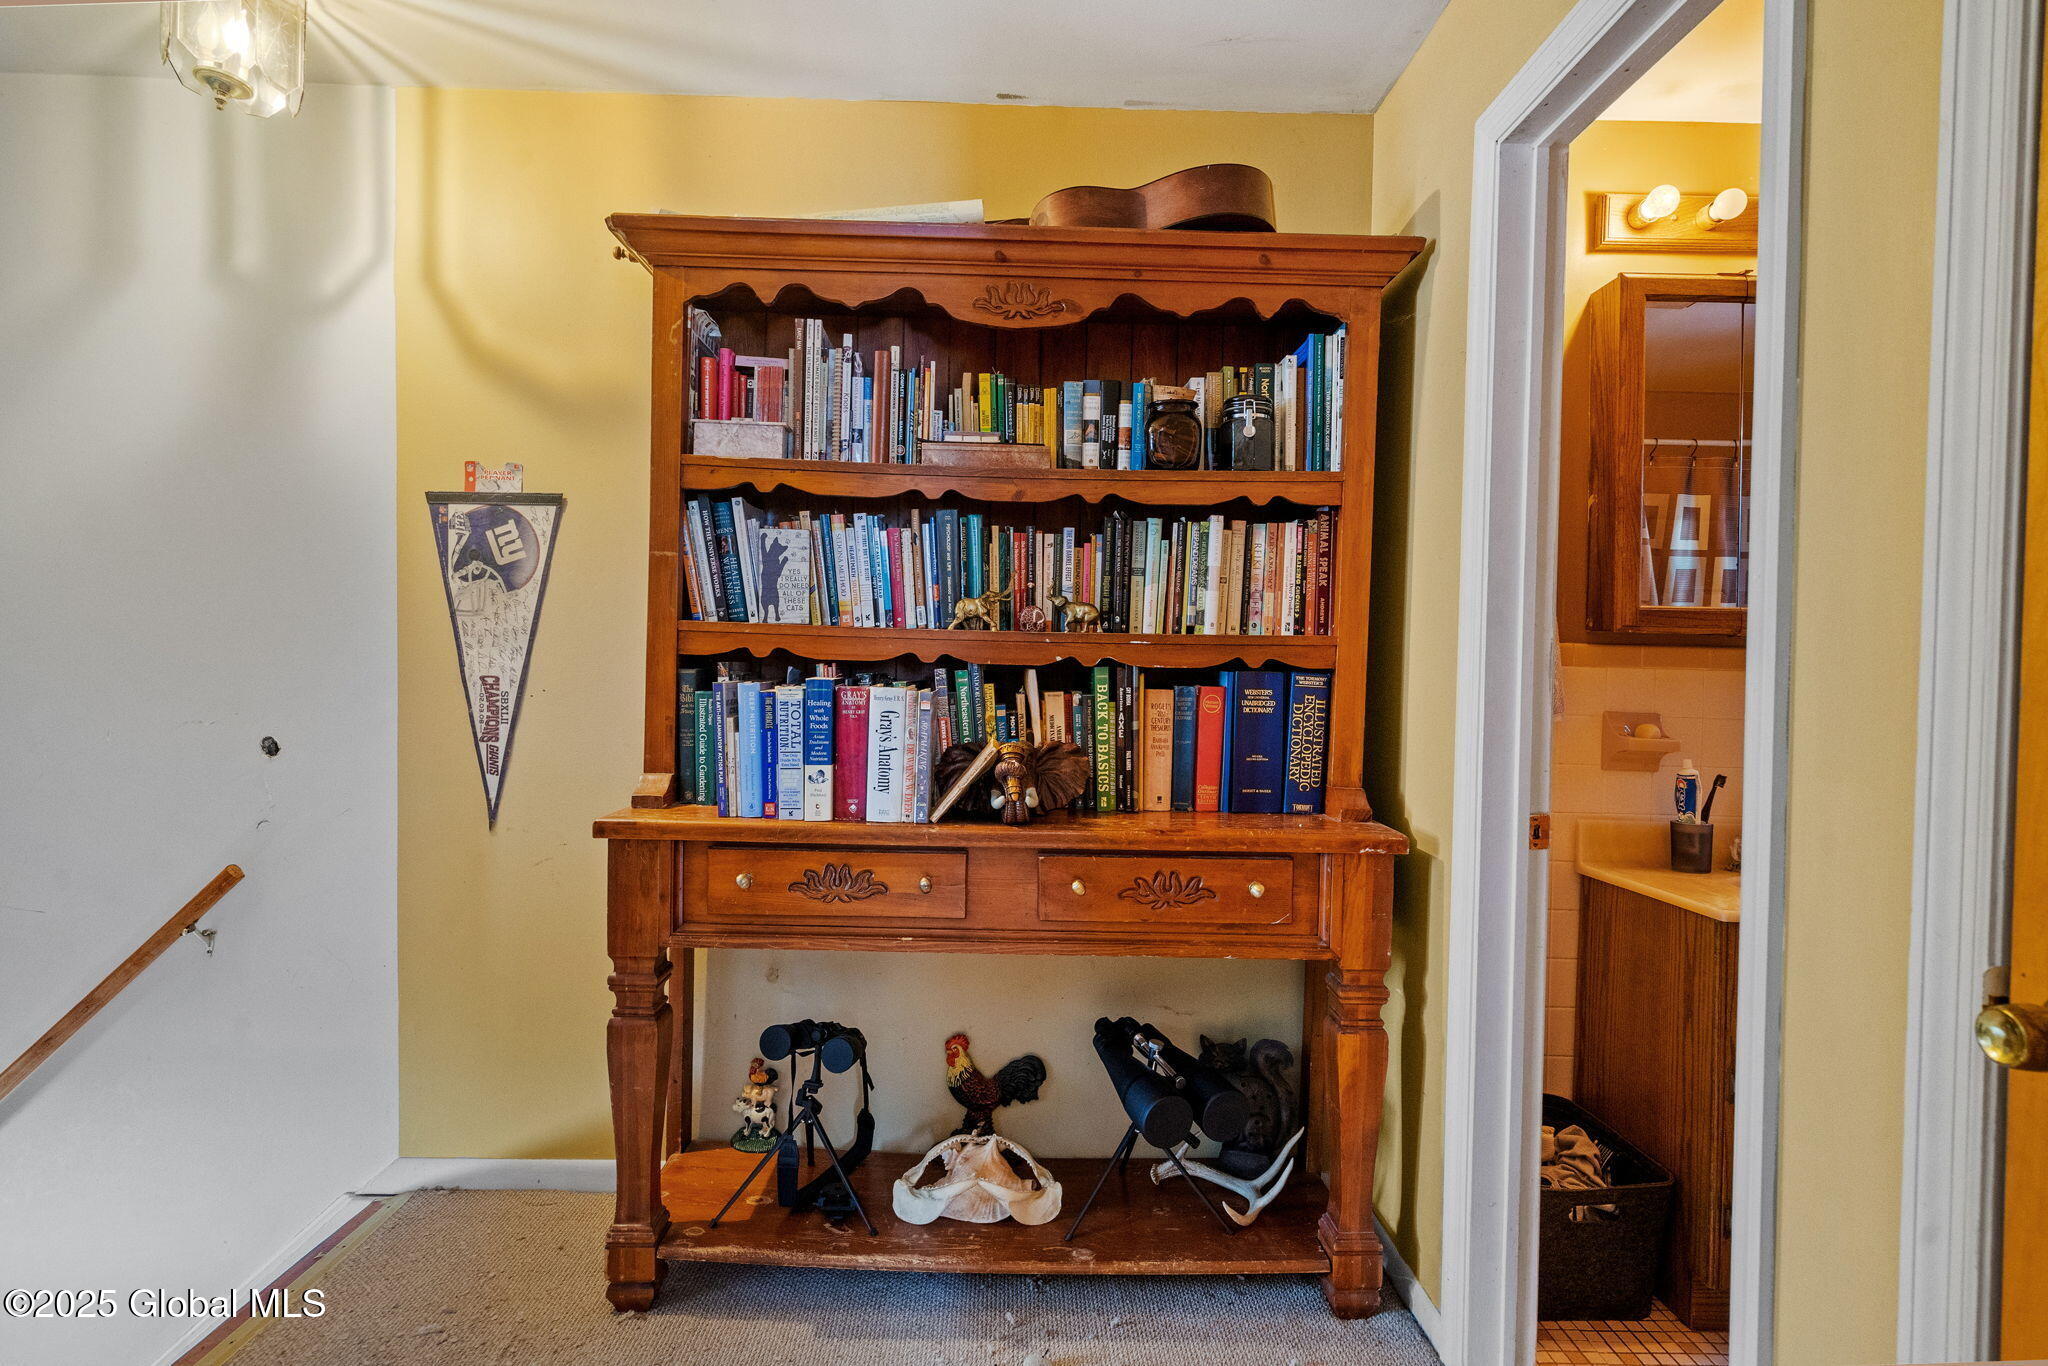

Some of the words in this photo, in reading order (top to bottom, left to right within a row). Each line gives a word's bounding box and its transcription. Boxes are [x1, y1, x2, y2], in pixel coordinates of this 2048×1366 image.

[836, 533, 844, 562] SEDONA
[1320, 514, 1329, 553] ANIMAL
[707, 542, 716, 573] UNIVERSE
[712, 575, 721, 597] WORKS
[723, 557, 735, 604] WELLNESS
[730, 557, 741, 592] HEALTH
[839, 565, 847, 597] METHOD
[1319, 557, 1328, 586] SPEAK
[479, 675, 500, 743] CHAMPIONS
[501, 691, 509, 724] SBXLII
[841, 691, 867, 700] GRAY'S
[959, 686, 970, 735] Northeastern
[1097, 684, 1108, 720] BACK
[699, 698, 707, 732] Illustrated
[790, 701, 801, 748] TOTAL
[876, 710, 900, 742] Gray's
[950, 705, 958, 744] Blacksmith's
[1097, 724, 1108, 741] TO
[489, 744, 499, 776] GIANTS
[699, 734, 707, 754] Guide
[699, 756, 707, 764] to
[918, 720, 928, 771] SOAPMAKING
[1289, 703, 1303, 782] DICTIONARY
[1299, 694, 1315, 792] ENCYCLOPEDIC
[1311, 699, 1326, 788] ILLUSTRATED
[698, 765, 707, 801] Gardening
[874, 745, 898, 794] Anatomy
[905, 757, 915, 782] WAYNE
[1097, 744, 1109, 792] BASICS
[904, 794, 914, 814] DYER
[1677, 779, 1686, 810] Crest
